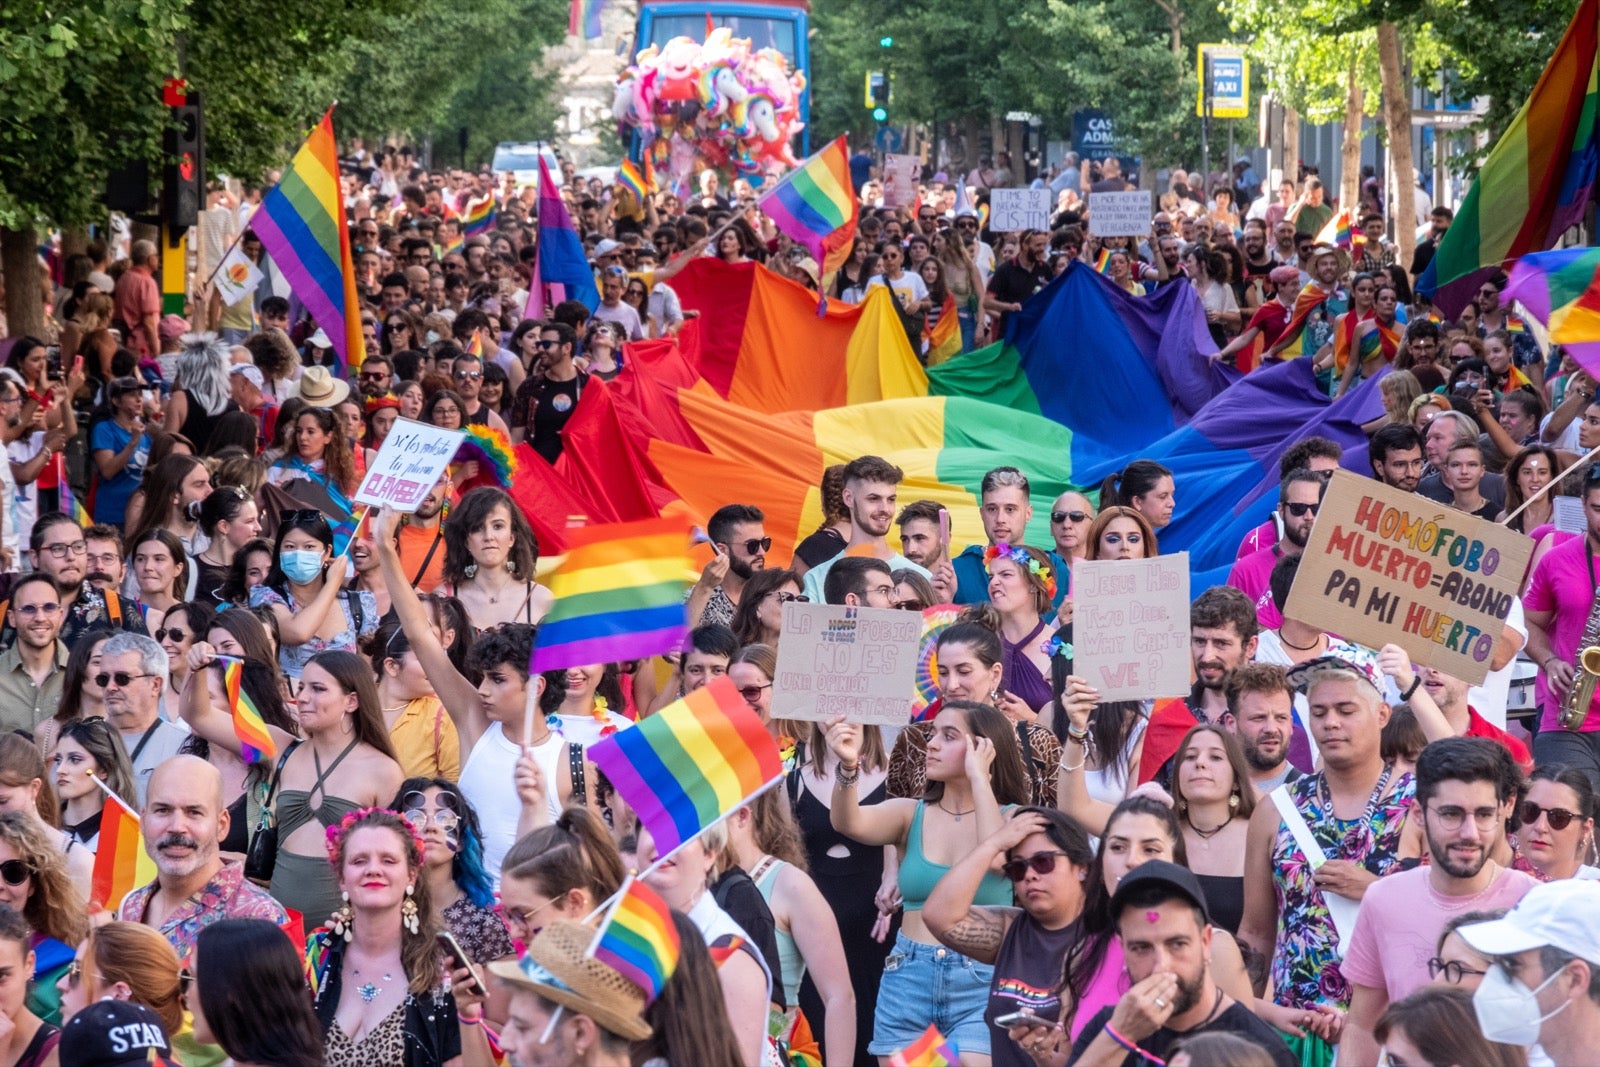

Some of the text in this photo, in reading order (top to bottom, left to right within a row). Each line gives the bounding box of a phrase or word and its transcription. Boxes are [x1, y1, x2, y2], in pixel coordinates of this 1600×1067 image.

[1214, 82, 1237, 92] AXI
[998, 191, 1041, 200] TIME TO
[1027, 200, 1041, 209] THE
[1354, 495, 1500, 576] HOMÓFOBO
[786, 606, 916, 642] LA HOMO FOBIA
[1324, 569, 1493, 663] PA MI HUERTO
[820, 631, 856, 644] TRANS
[814, 643, 899, 675] NO ES
[780, 672, 812, 691] UNA
[816, 694, 910, 717] RESPETABLE
